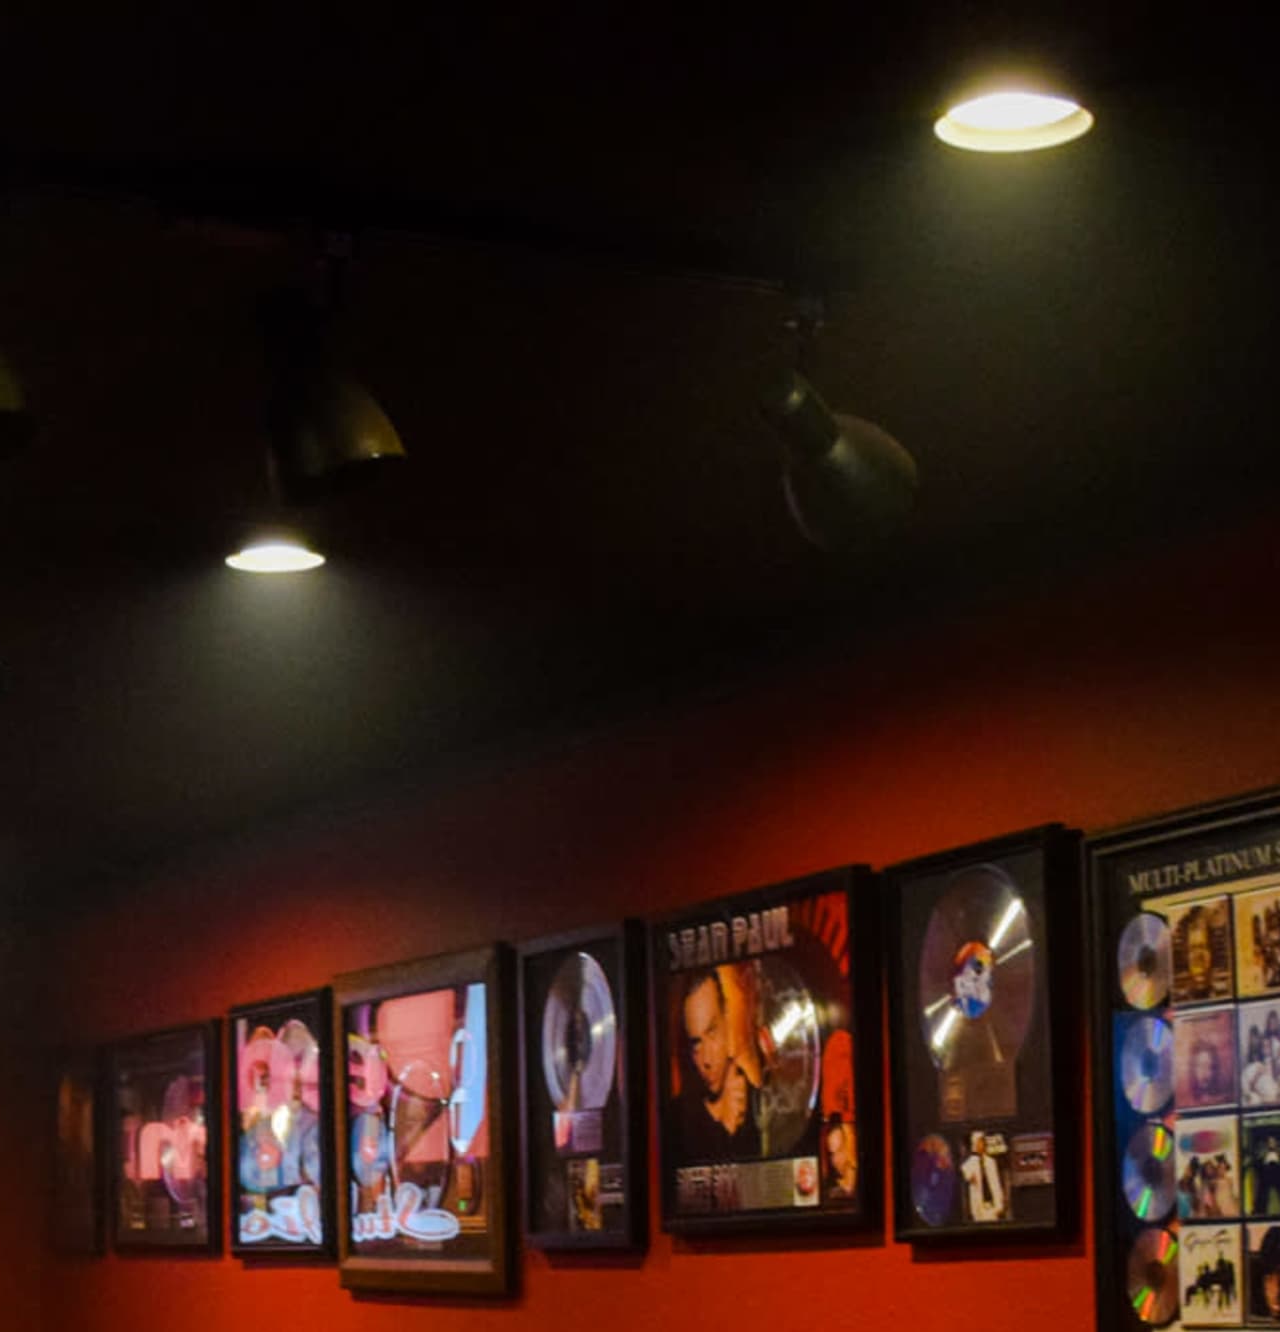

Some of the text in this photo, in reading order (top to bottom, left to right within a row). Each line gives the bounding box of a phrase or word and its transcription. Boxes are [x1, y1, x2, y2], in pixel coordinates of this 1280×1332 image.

[1128, 845, 1270, 896] MULTI-PLATINUM
[668, 905, 794, 971] SEAN PAUL
